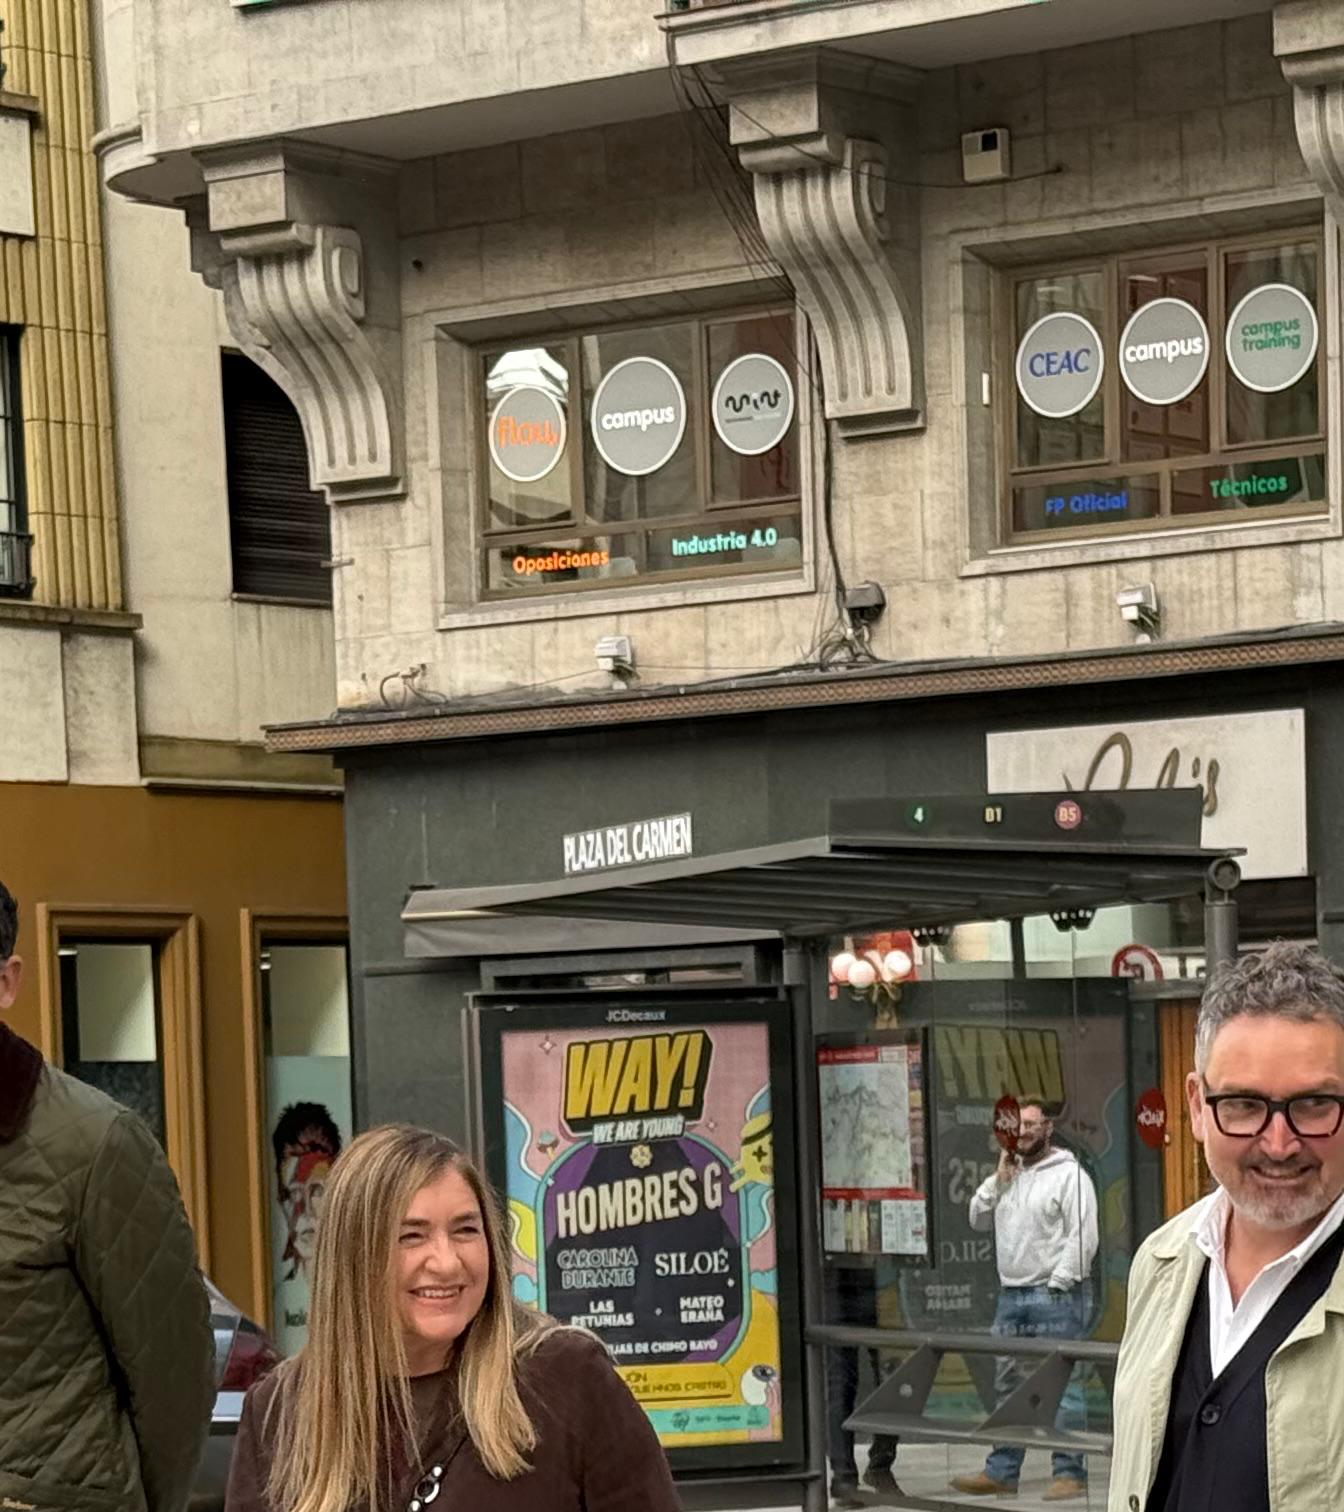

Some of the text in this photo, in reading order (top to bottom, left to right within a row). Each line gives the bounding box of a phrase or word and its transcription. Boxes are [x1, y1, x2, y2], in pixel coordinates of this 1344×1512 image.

[1242, 318, 1301, 339] campus
[1125, 335, 1203, 363] campus
[1241, 334, 1301, 352] training
[1029, 348, 1091, 377] CEAC
[601, 406, 675, 432] campus
[1210, 474, 1288, 499] Técnicos
[1045, 497, 1065, 515] FP
[672, 528, 778, 557] Industria 4.0
[513, 550, 610, 576] Oposiciones
[914, 807, 925, 823] 4
[563, 815, 692, 873] PLAZA DEL CARMEN
[565, 1032, 704, 1120] WAY!
[593, 1114, 684, 1144] WE ARE YOUNG
[557, 1161, 723, 1239] HOMBRES G
[557, 1246, 640, 1270] CAROLINA
[655, 1248, 730, 1276] SILOÉ
[562, 1268, 636, 1289] DURANTE
[589, 1299, 615, 1313] LAS
[680, 1295, 724, 1309] MATEO
[635, 1341, 649, 1354] DE
[650, 1340, 688, 1354] CHIMO
[689, 1338, 718, 1351] BAYO
